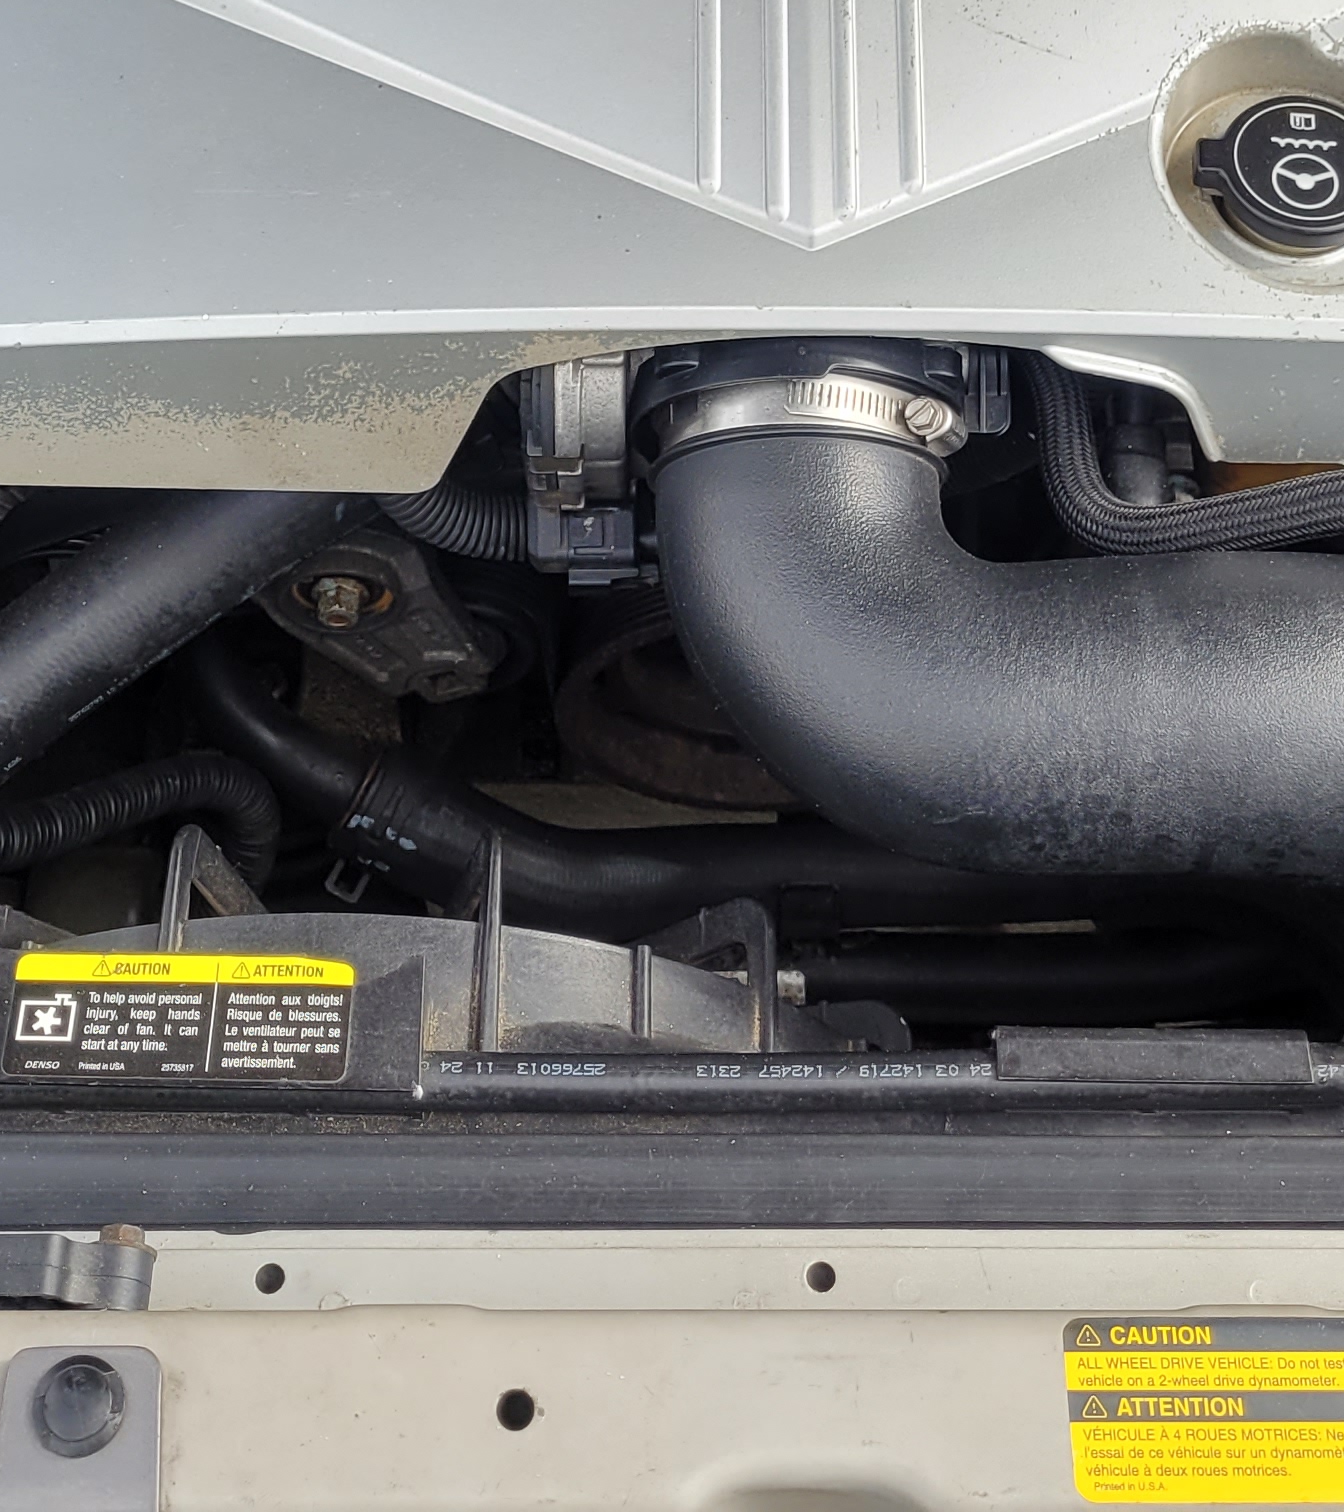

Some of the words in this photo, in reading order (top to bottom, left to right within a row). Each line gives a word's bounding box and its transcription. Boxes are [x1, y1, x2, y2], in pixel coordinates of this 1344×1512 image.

[115, 963, 171, 976] CAUTION
[253, 965, 324, 978] ATTENTION
[89, 992, 102, 1005] To
[104, 992, 125, 1006] help
[128, 993, 155, 1005] avoid
[158, 993, 202, 1007] personal
[228, 993, 275, 1005] Attention
[282, 996, 301, 1005] aux
[308, 995, 343, 1008] doigts!
[86, 1008, 118, 1022] injury,
[130, 1008, 156, 1022] keep
[168, 1008, 200, 1020] hands
[227, 1009, 263, 1023] Risque
[269, 1009, 283, 1021] de
[288, 1009, 341, 1022] blessures.
[84, 1023, 110, 1035] clear
[117, 1023, 129, 1035] of
[136, 1023, 155, 1036] fan.
[164, 1024, 172, 1036] It
[179, 1025, 198, 1036] can
[225, 1025, 238, 1037] Le
[243, 1025, 296, 1037] ventilateur
[301, 1026, 324, 1039] peut
[328, 1028, 340, 1038] se
[81, 1039, 105, 1051] start
[107, 1040, 118, 1051] at
[120, 1041, 140, 1053] any
[223, 1041, 257, 1053] mettre
[262, 1040, 268, 1053] à
[273, 1042, 310, 1054] tourner
[315, 1044, 340, 1054] sans
[25, 1061, 60, 1069] DENSO
[79, 1062, 101, 1070] Printed
[103, 1062, 108, 1070] in
[109, 1062, 125, 1071] USA
[221, 1057, 296, 1069] avertissement.
[439, 1060, 464, 1074] 24
[517, 1062, 606, 1077] 25766013
[935, 1063, 959, 1077] 03
[970, 1063, 993, 1077] 24
[696, 1064, 742, 1078] 2313
[758, 1064, 825, 1079] 142457
[858, 1064, 923, 1078] 142719
[1110, 1326, 1212, 1345] CAUTION
[1078, 1358, 1103, 1370] ALL
[1106, 1358, 1156, 1370] WHEEL
[1160, 1358, 1205, 1370] DRIVE
[1207, 1358, 1273, 1370] VEHICLE:
[1278, 1358, 1295, 1370] Do
[1300, 1358, 1319, 1370] not
[1078, 1375, 1122, 1387] vehicle
[1127, 1378, 1141, 1387] on
[1147, 1378, 1154, 1387] a
[1159, 1375, 1209, 1387] 2-wheel
[1214, 1375, 1244, 1387] drive
[1248, 1375, 1340, 1389] dynamometer.
[1117, 1397, 1244, 1417] ATTENTION
[1083, 1426, 1155, 1441] VÉHICULE
[1160, 1426, 1170, 1440] À
[1173, 1429, 1181, 1441] 4
[1186, 1429, 1237, 1441] ROUES
[1241, 1429, 1322, 1441] MOTRICES:
[1326, 1429, 1344, 1441] Ne
[1084, 1446, 1124, 1459] l'essai
[1128, 1446, 1144, 1459] de
[1148, 1450, 1164, 1459] ce
[1168, 1446, 1222, 1459] véhicule
[1226, 1450, 1246, 1459] sur
[1250, 1450, 1266, 1459] un
[1086, 1464, 1139, 1477] véhicule
[1144, 1464, 1152, 1477] à
[1156, 1464, 1188, 1477] deux
[1192, 1467, 1228, 1477] roues
[1232, 1465, 1292, 1477] motrices.
[1094, 1482, 1125, 1491] Printed
[1128, 1482, 1135, 1491] in
[1138, 1482, 1167, 1491] U.S.A.
